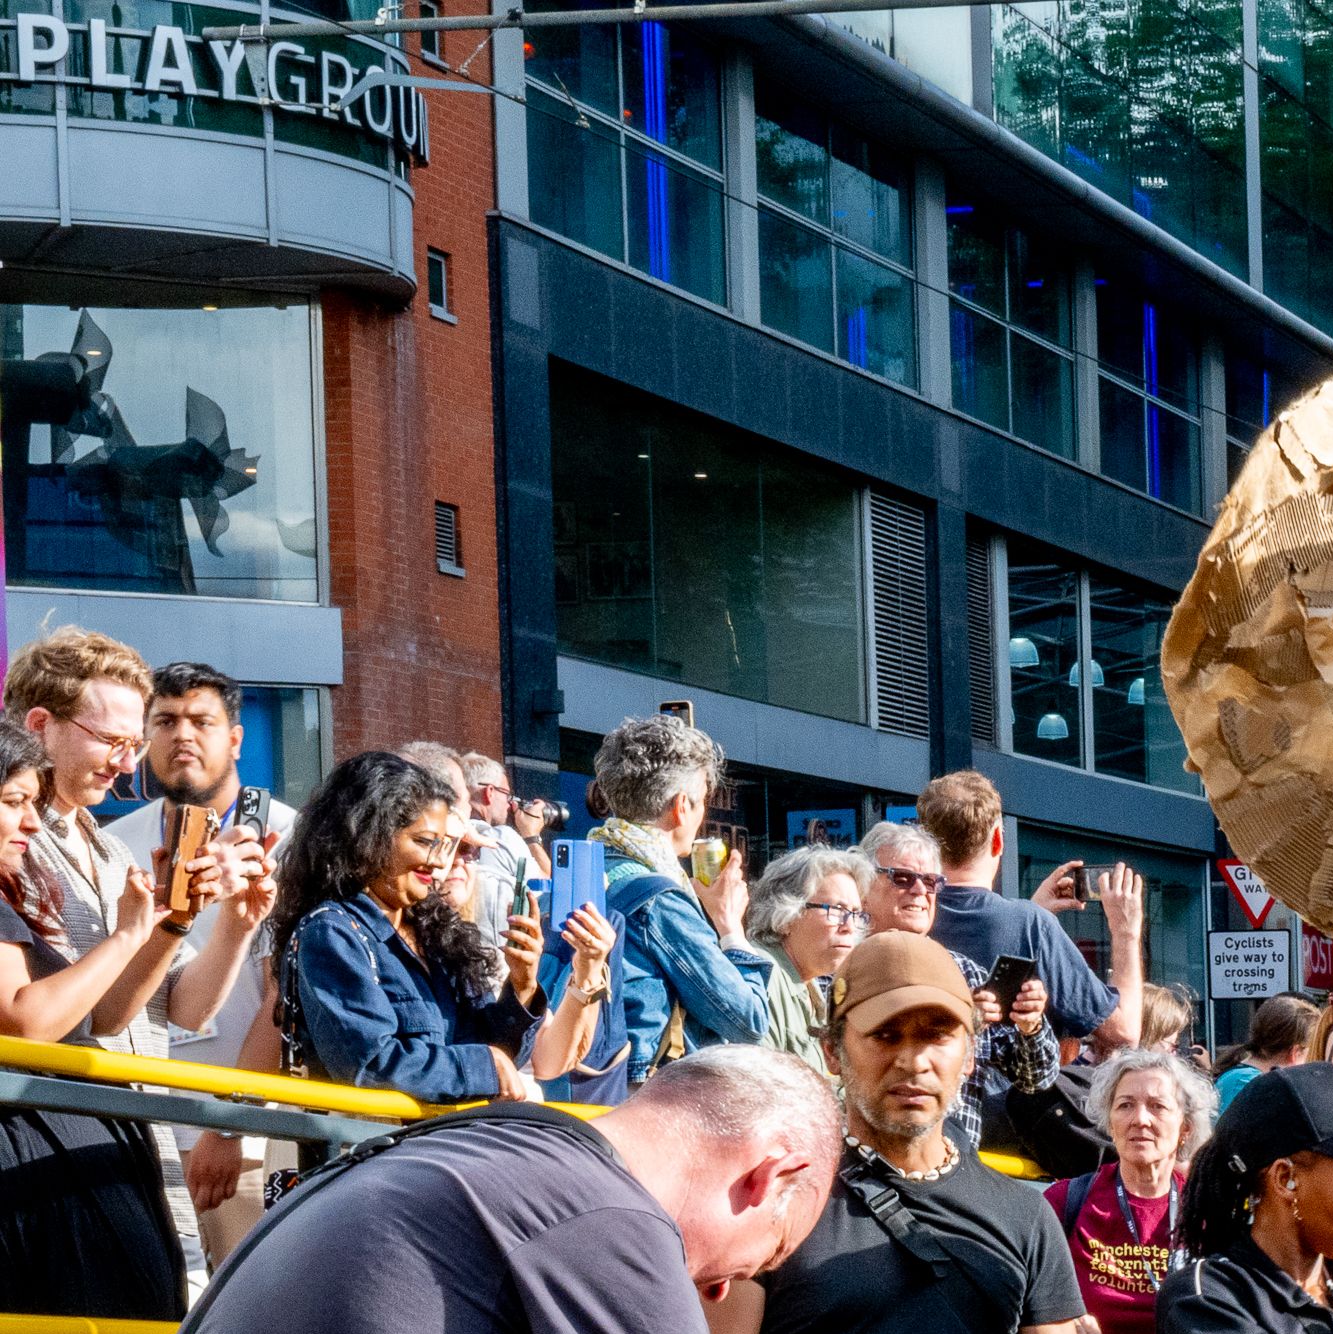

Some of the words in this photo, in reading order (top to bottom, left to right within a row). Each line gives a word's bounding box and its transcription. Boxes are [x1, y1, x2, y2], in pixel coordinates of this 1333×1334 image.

[1234, 867, 1253, 881] GI
[1224, 937, 1274, 951] Cyclists
[1214, 952, 1239, 966] give
[1243, 953, 1268, 964] way
[1272, 952, 1284, 963] to
[1302, 934, 1333, 975] POST
[1224, 966, 1275, 979] crossing
[1088, 1273, 1157, 1294] volunte
